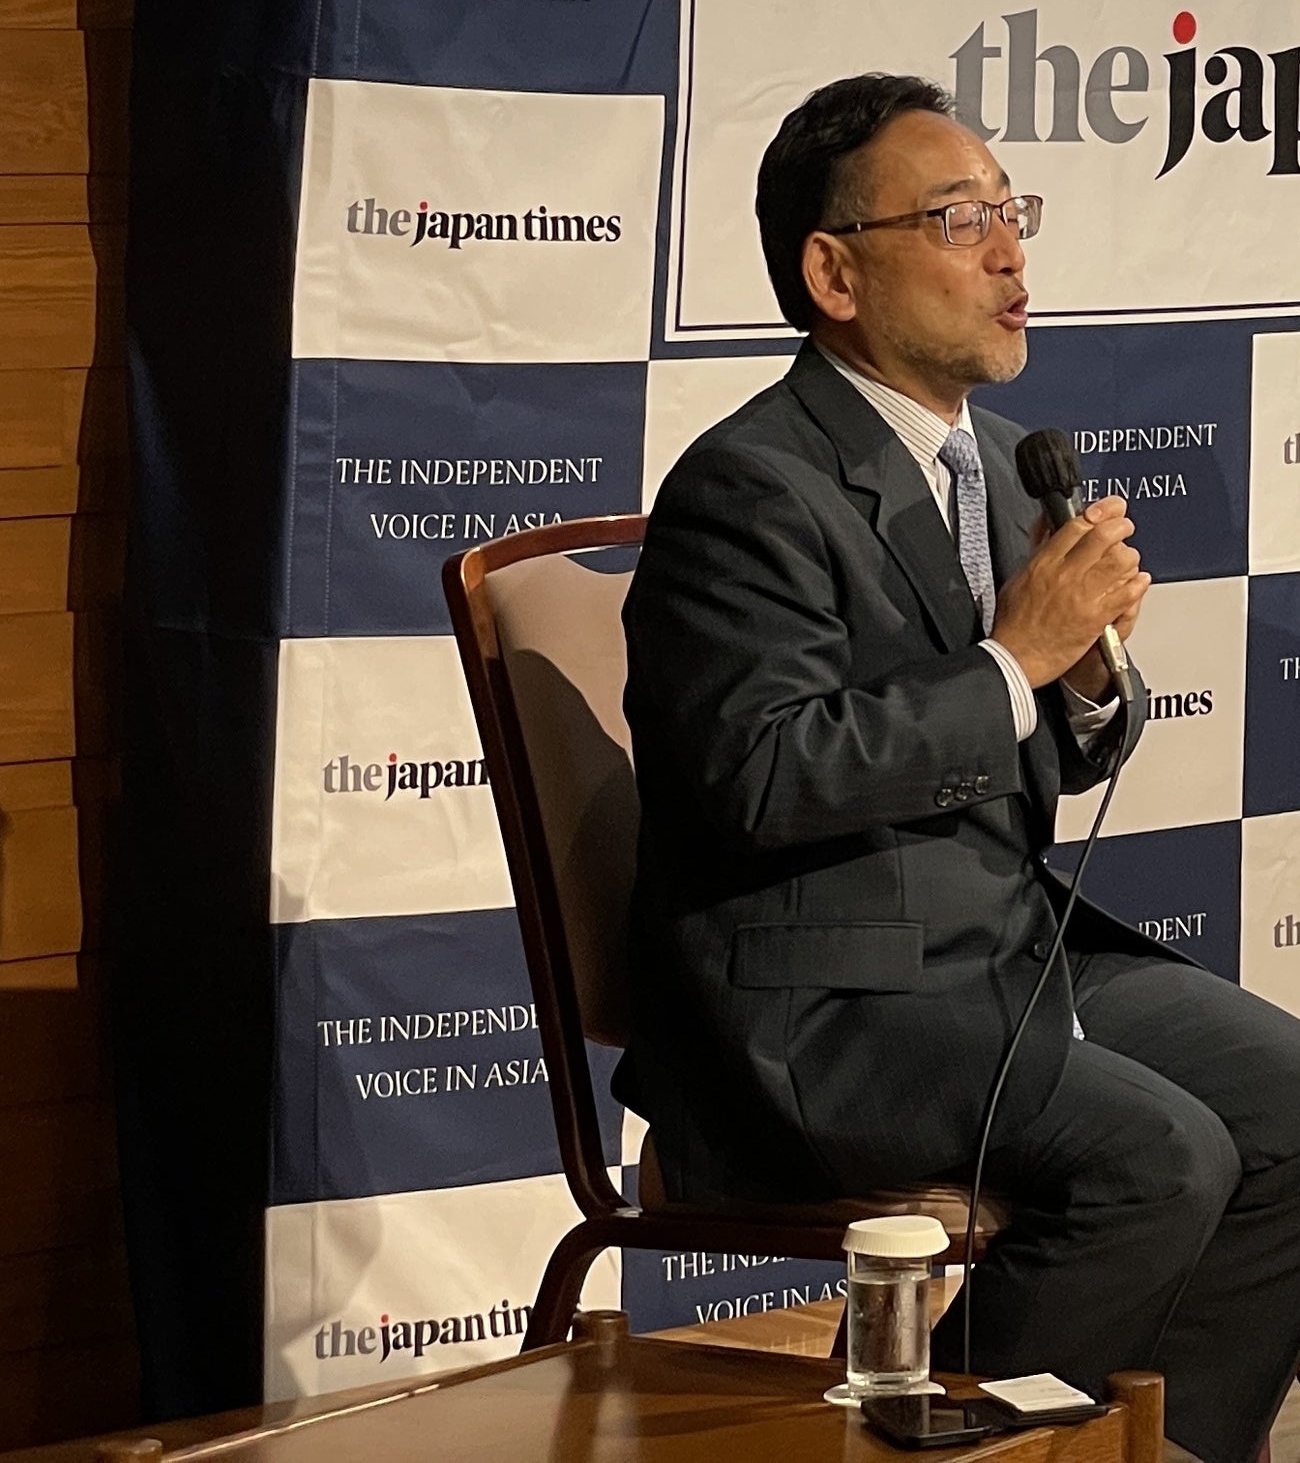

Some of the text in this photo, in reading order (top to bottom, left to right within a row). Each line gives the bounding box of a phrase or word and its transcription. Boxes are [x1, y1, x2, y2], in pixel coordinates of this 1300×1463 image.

[336, 456, 604, 486] THE INDEPENDENT
[1135, 473, 1188, 501] ASIA
[369, 513, 456, 540] VOICE
[463, 512, 496, 540] IN
[317, 1018, 372, 1048] THE
[355, 1057, 550, 1100] VOICE IN ASIA
[661, 1252, 716, 1282] THE
